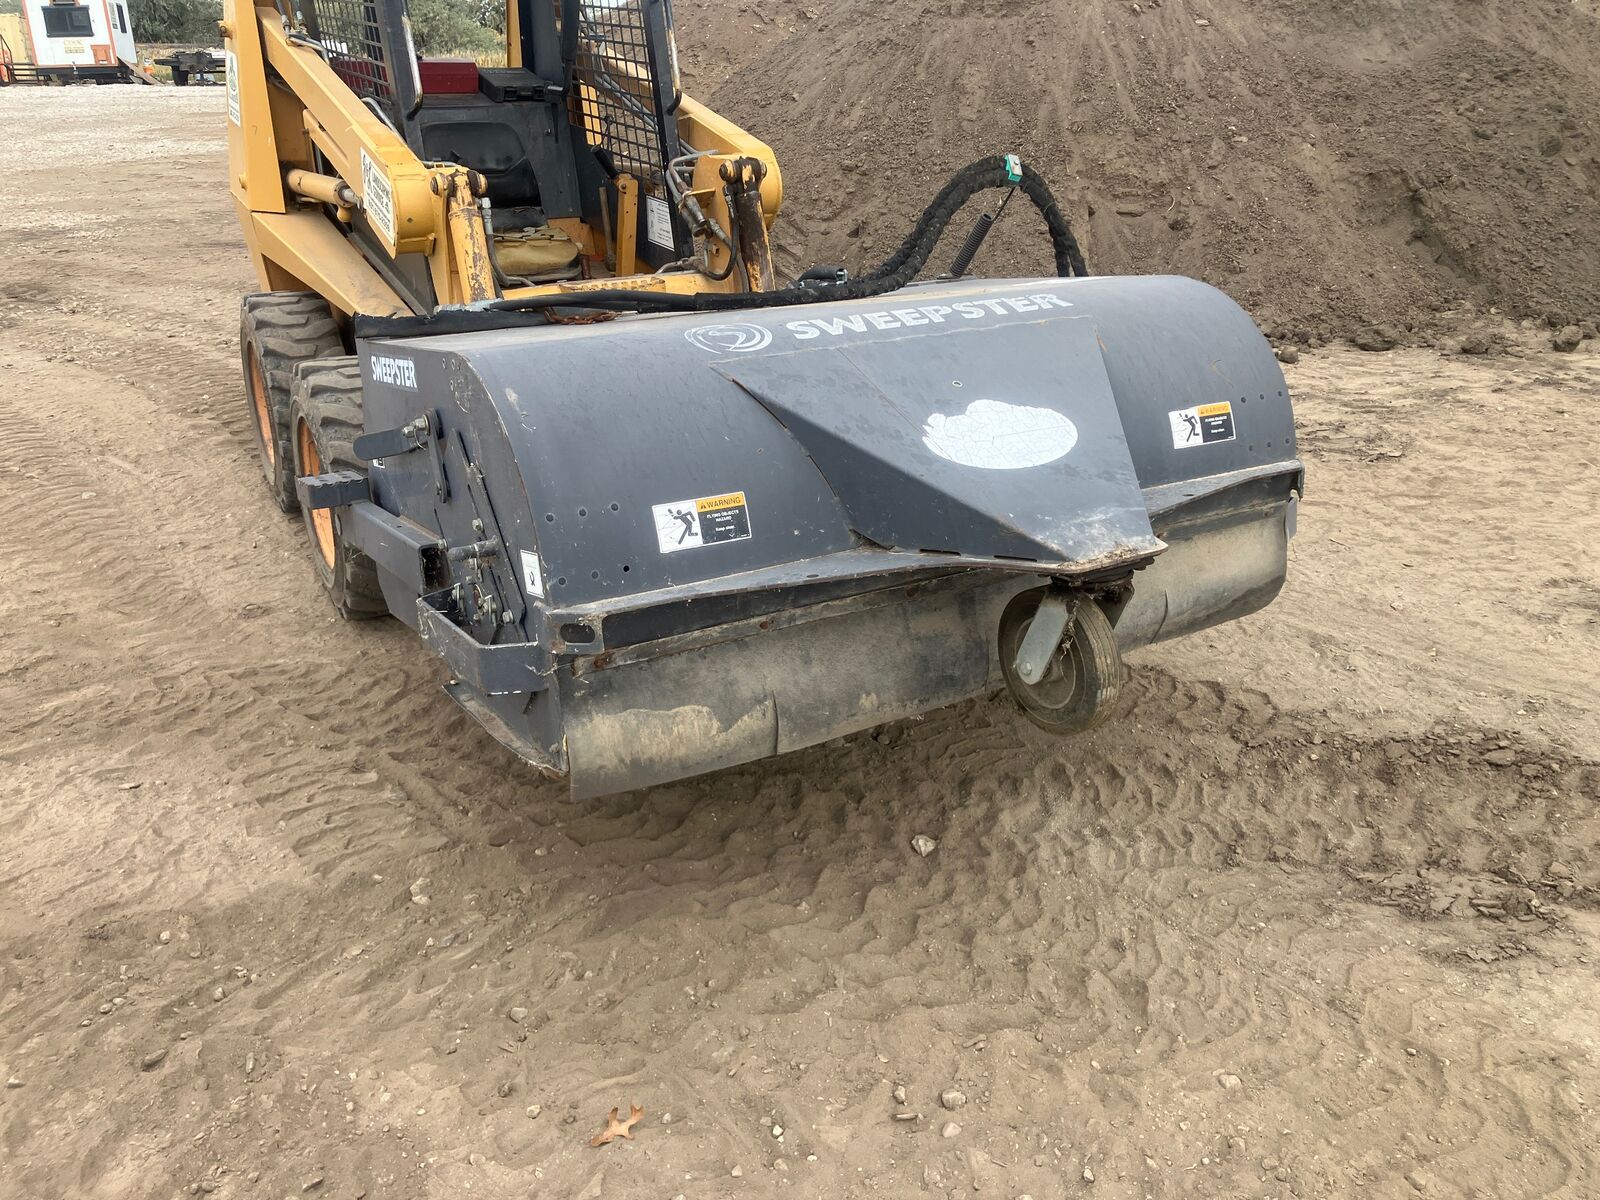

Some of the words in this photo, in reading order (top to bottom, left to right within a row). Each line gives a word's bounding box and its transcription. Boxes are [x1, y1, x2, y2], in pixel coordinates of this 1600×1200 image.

[785, 293, 1074, 340] SWEEPSTER
[371, 355, 418, 388] SWEEPSTER
[707, 496, 741, 508] WARNING
